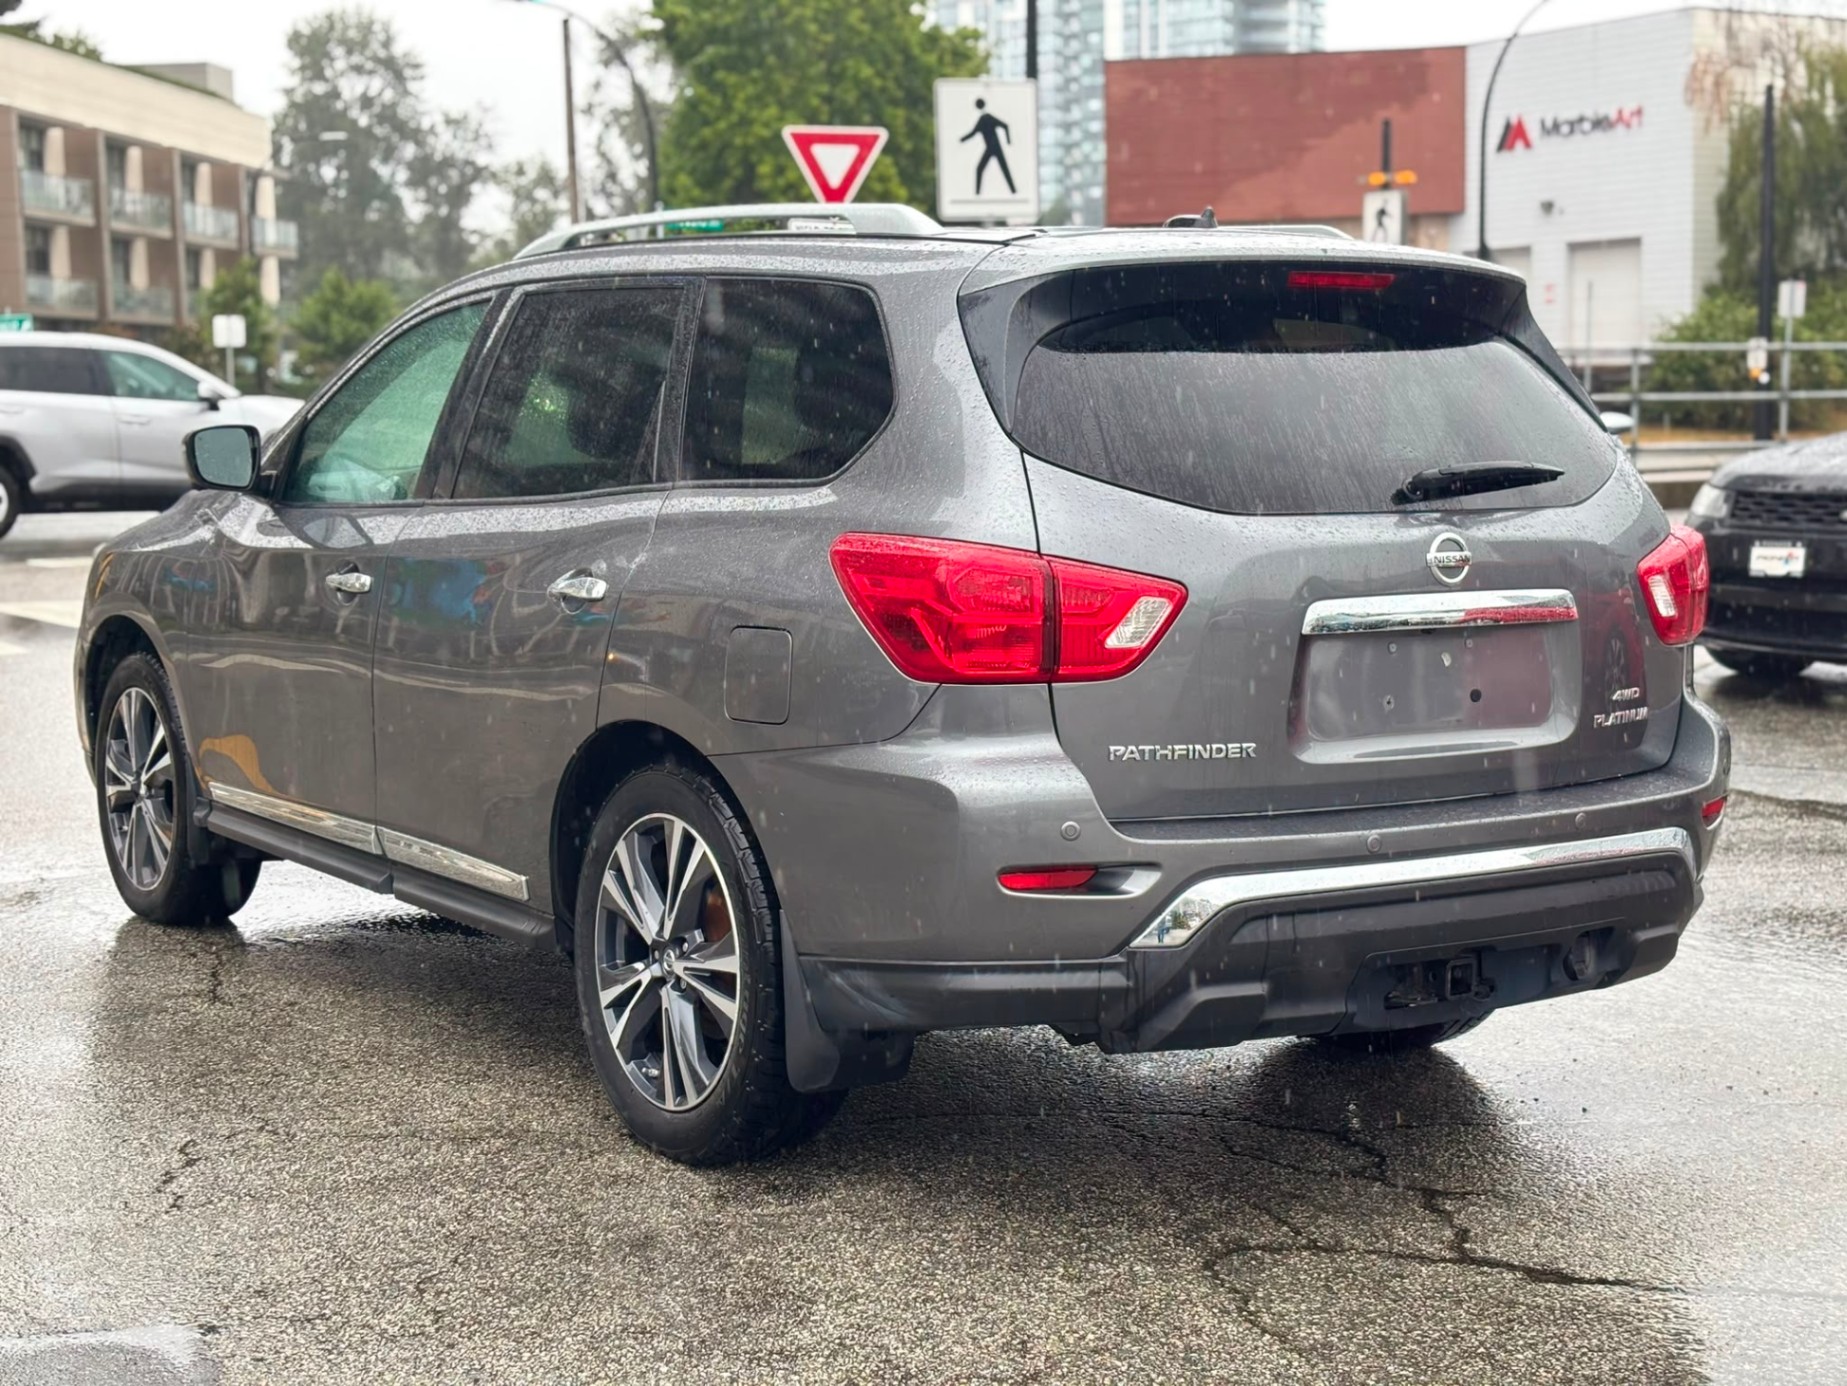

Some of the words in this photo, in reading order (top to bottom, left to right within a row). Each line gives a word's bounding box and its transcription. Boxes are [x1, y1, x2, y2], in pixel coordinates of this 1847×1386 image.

[1433, 554, 1471, 564] NISSAN
[1611, 687, 1640, 701] 4WD
[1594, 706, 1648, 728] PLATINUM
[1109, 743, 1257, 761] PATHFINDER
